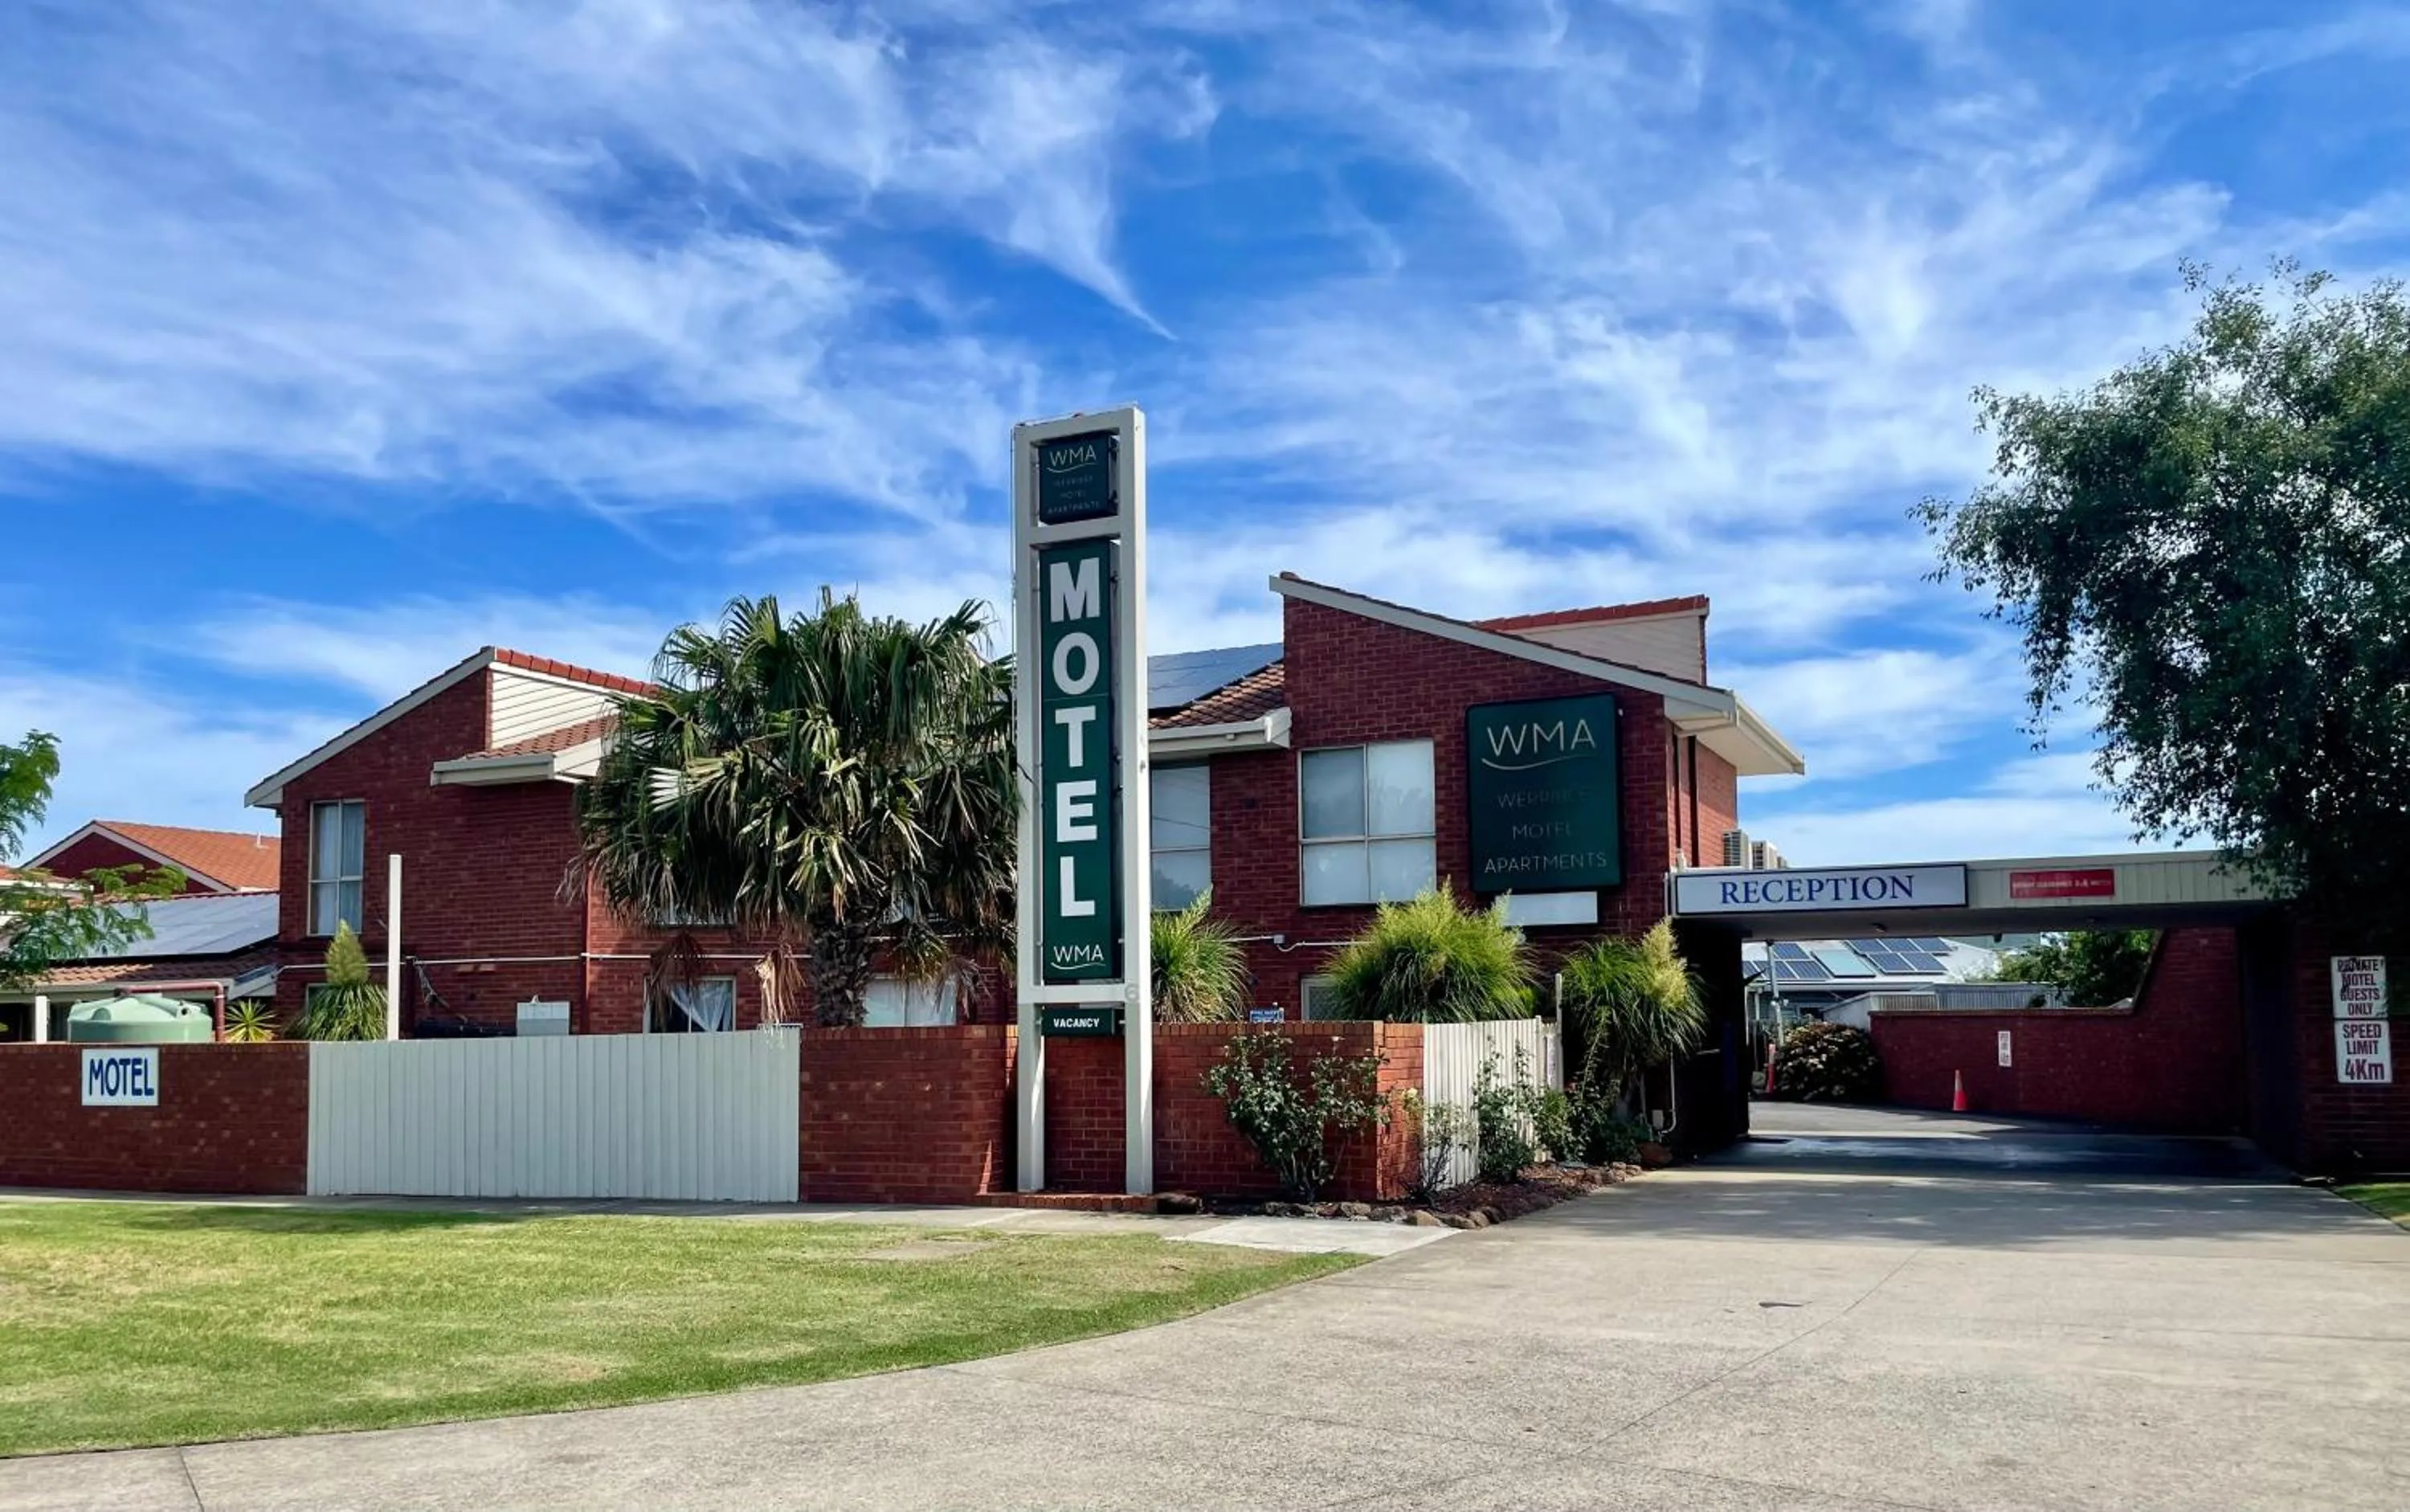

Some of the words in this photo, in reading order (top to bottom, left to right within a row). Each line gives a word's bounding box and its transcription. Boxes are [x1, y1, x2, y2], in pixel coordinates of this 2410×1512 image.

[1049, 444, 1097, 467] WMA
[1049, 557, 1101, 917] MOTEL
[1487, 719, 1595, 757] WMA
[1512, 820, 1572, 840] MOTEL
[1484, 852, 1607, 874] APARTMENTS
[1719, 875, 1914, 905] RECEPTION
[1053, 944, 1105, 962] WMA
[2341, 973, 2377, 987] MOTEL
[2347, 1002, 2374, 1015] ONLY
[1053, 1018, 1100, 1028] VACANCY
[2343, 1024, 2382, 1039] SPEED
[2347, 1040, 2379, 1055] LIMIT
[89, 1057, 155, 1097] MOTEL
[2345, 1058, 2385, 1081] 4Km
